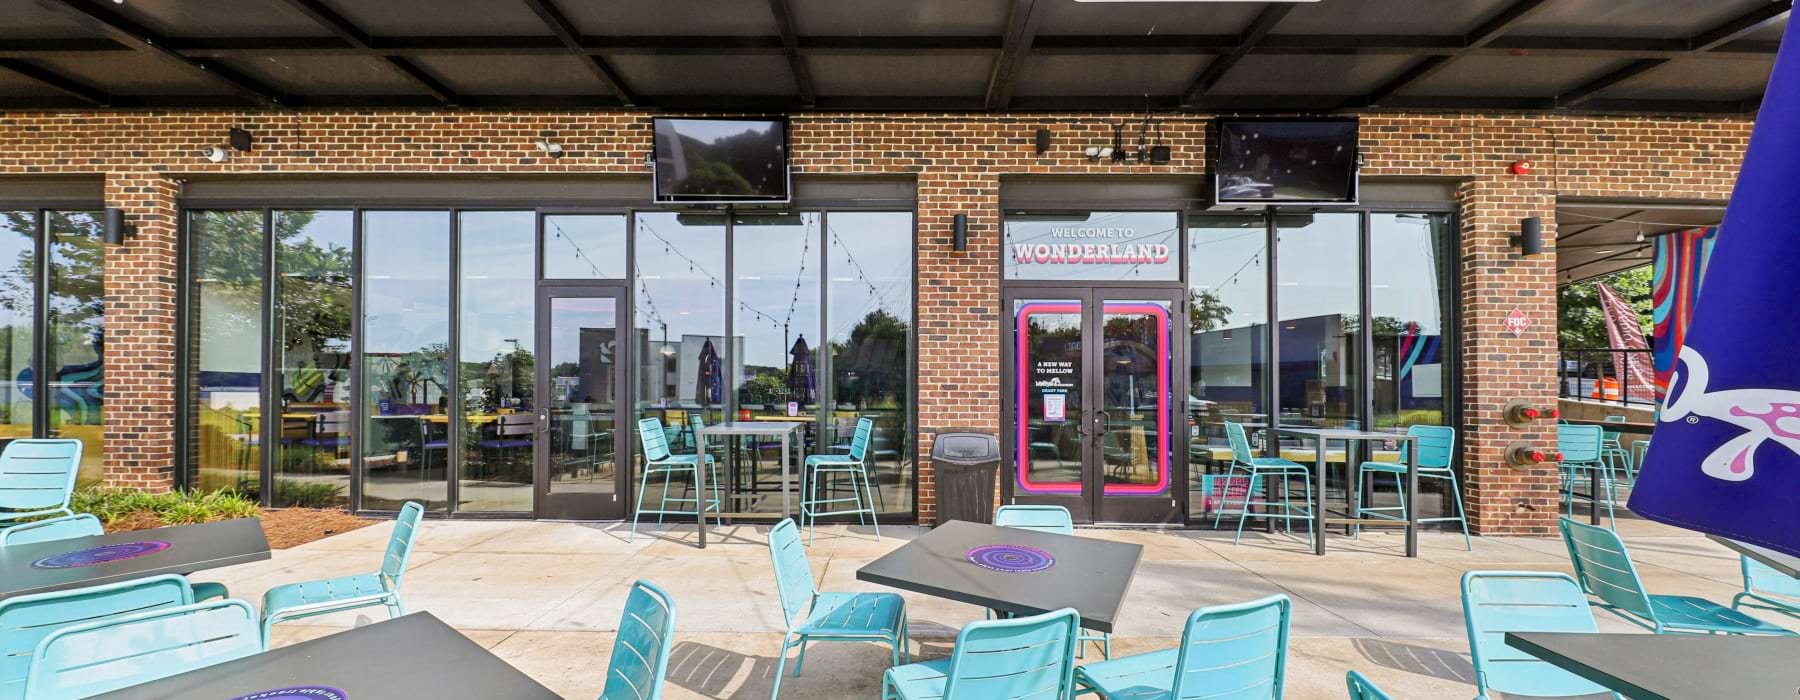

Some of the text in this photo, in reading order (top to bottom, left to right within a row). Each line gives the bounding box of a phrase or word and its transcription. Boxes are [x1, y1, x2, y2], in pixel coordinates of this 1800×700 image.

[1051, 228, 1134, 238] WELCOME TO
[1014, 243, 1169, 265] WONDERLAND
[1508, 317, 1527, 327] FDC
